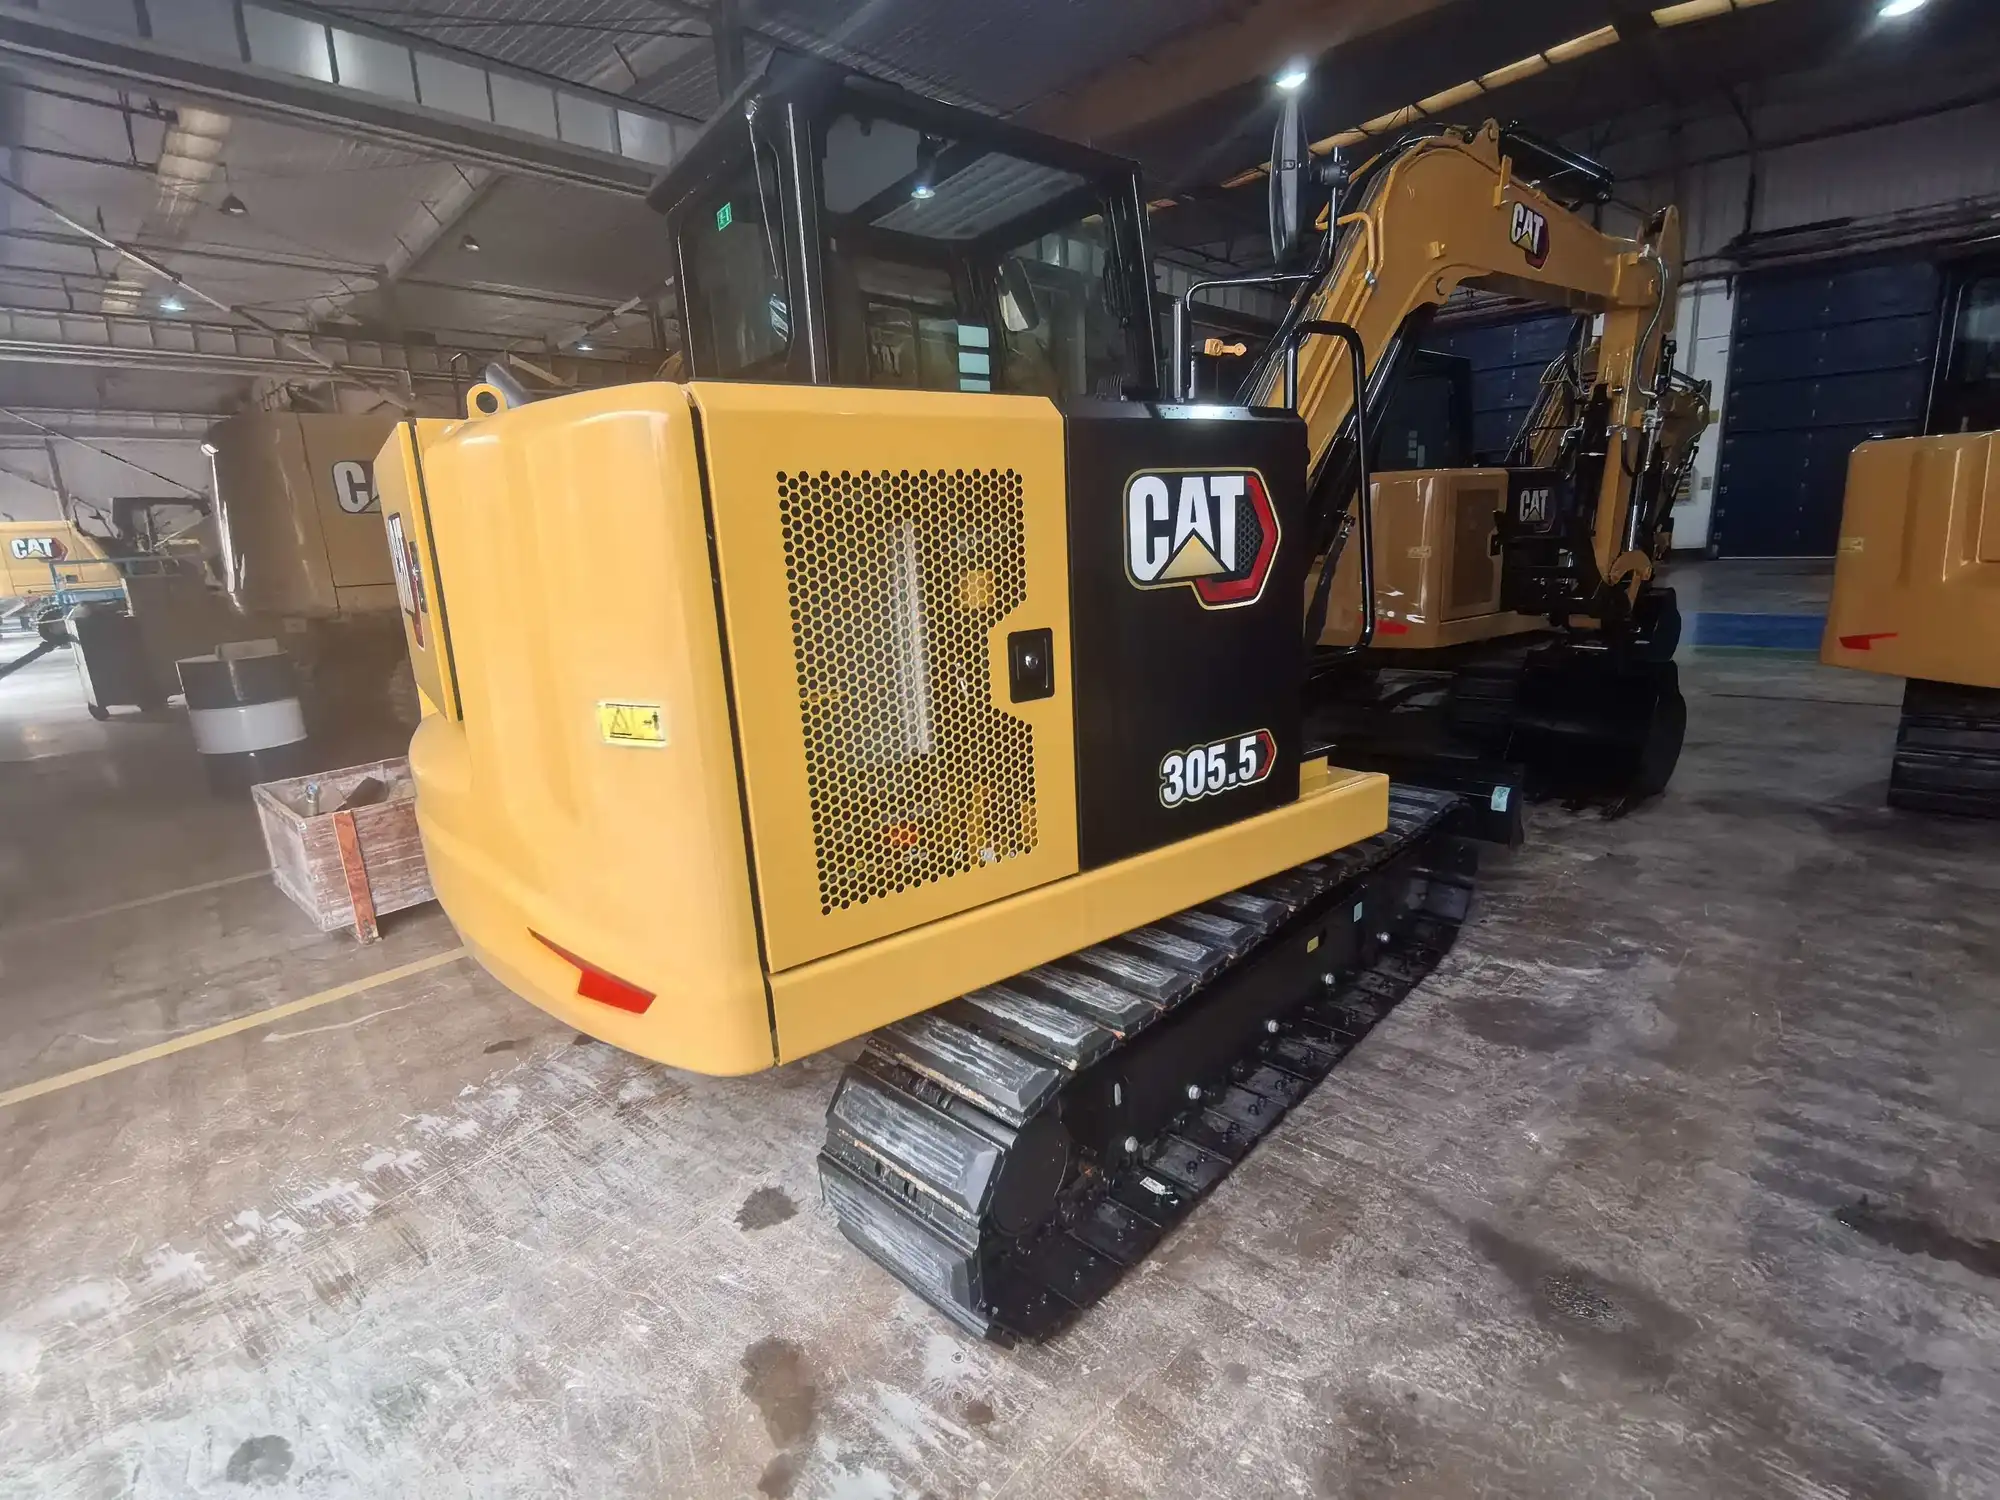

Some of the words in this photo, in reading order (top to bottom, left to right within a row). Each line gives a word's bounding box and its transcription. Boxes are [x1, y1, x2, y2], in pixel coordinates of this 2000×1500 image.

[1511, 203, 1544, 254] CAT
[333, 461, 379, 513] C
[1520, 490, 1549, 521] CAT
[11, 538, 53, 559] CAT
[1129, 476, 1245, 581] CAT
[1163, 735, 1257, 803] 305.5
